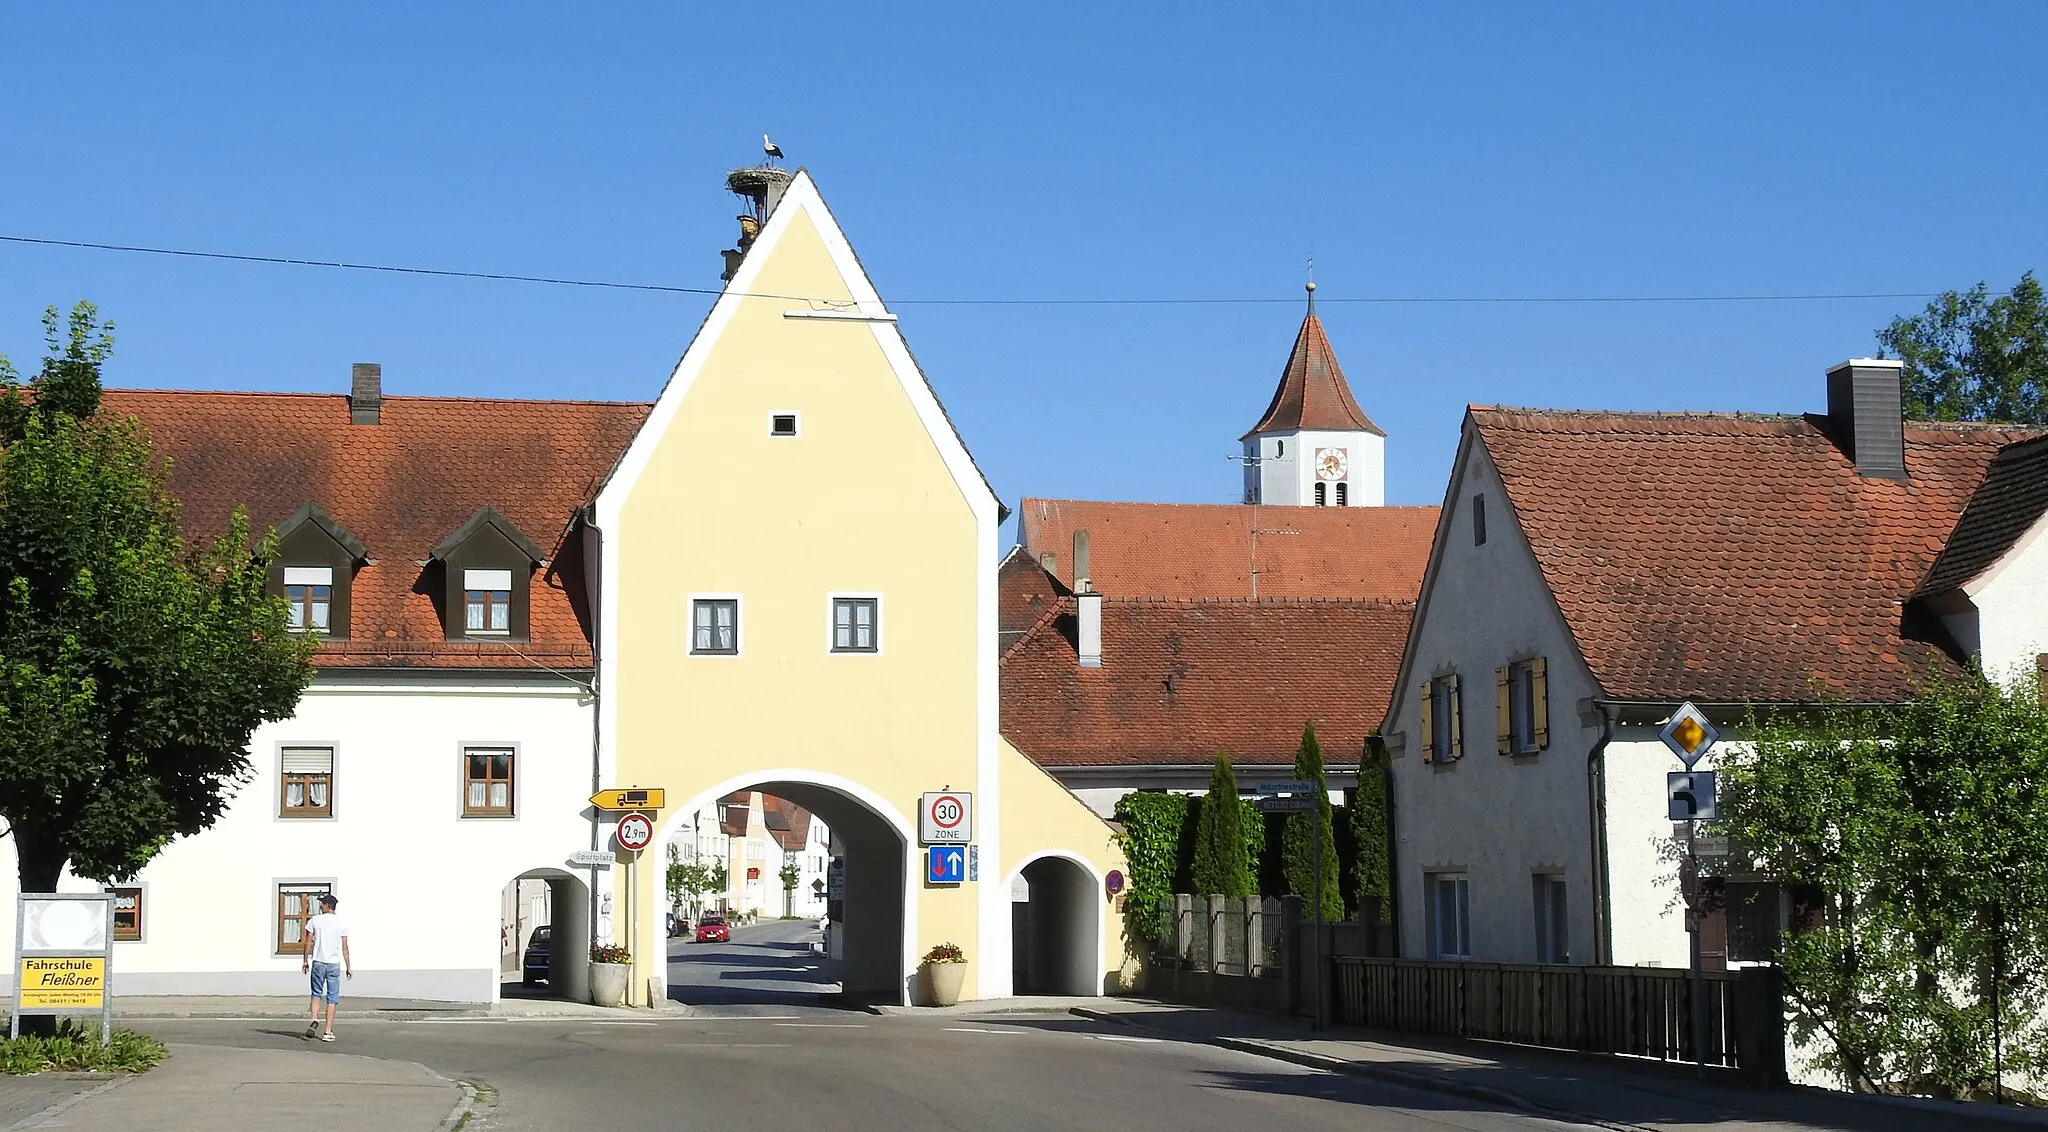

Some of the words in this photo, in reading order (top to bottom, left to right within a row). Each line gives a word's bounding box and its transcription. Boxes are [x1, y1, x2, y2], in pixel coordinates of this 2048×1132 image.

[938, 805, 957, 820] 30
[935, 830, 960, 839] ZONE
[576, 852, 613, 863] Sportplatz
[26, 960, 93, 970] Fahrschule
[41, 972, 99, 985] Fleißner
